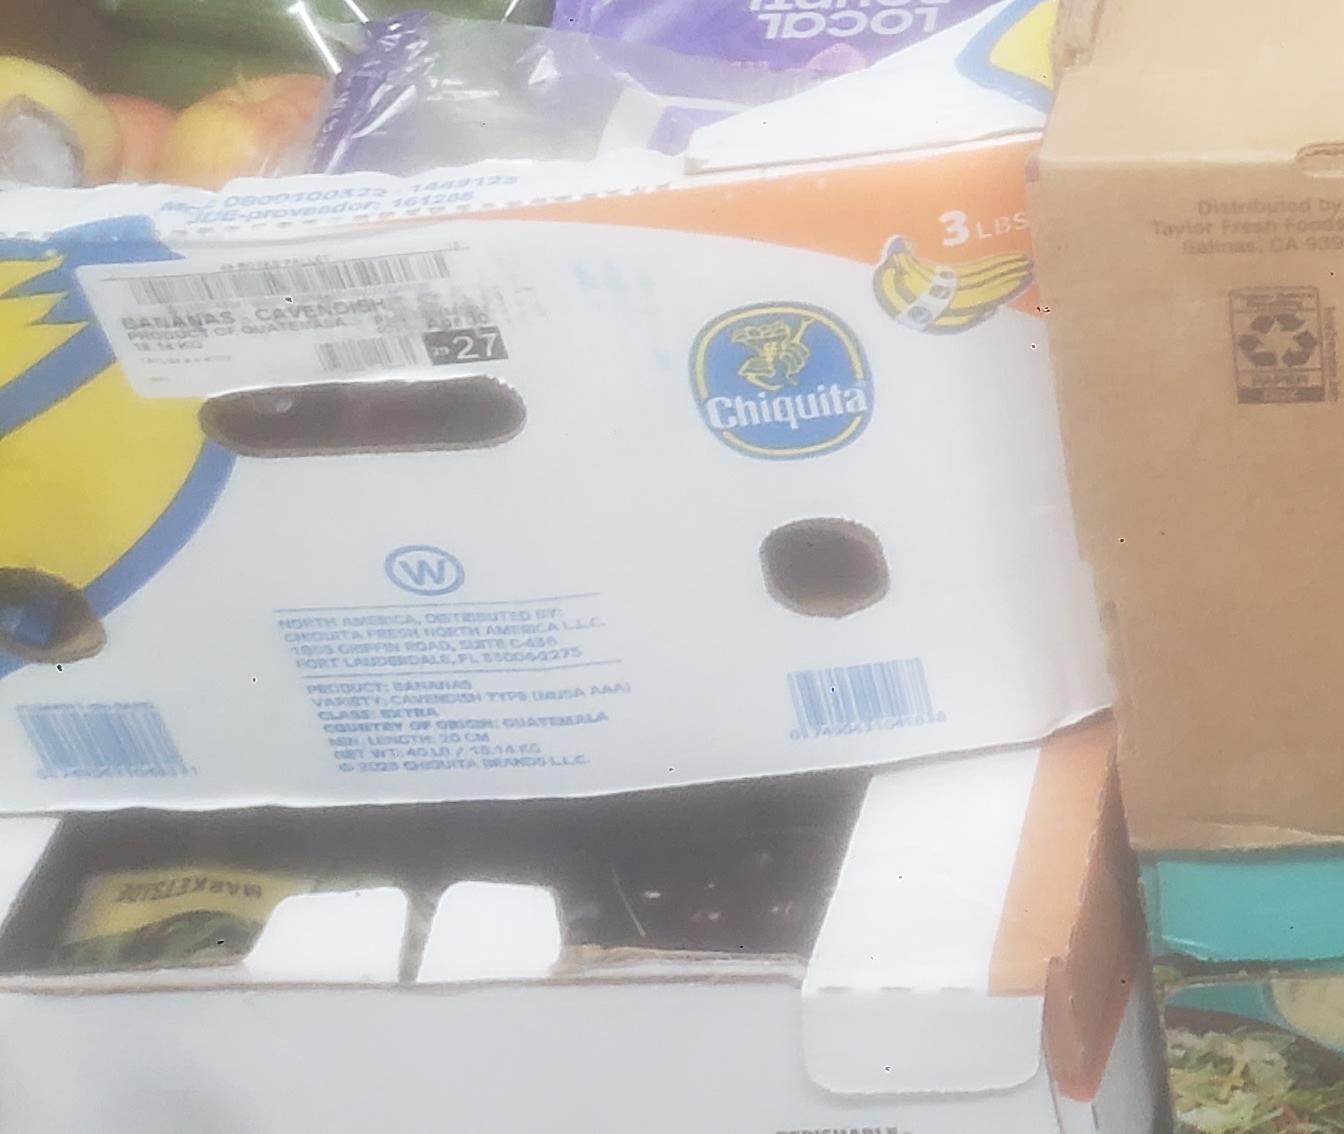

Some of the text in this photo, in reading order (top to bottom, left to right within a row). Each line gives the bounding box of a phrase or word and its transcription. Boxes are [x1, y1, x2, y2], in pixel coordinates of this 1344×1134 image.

[1198, 199, 1343, 215] Distributed by
[937, 209, 971, 247] 3
[1151, 219, 1213, 237] Taylor
[1222, 219, 1278, 234] Fresh
[1270, 236, 1300, 253] CA
[452, 332, 498, 360] 27
[705, 382, 870, 432] Chiquita
[115, 876, 263, 903] MARKETSIDE
